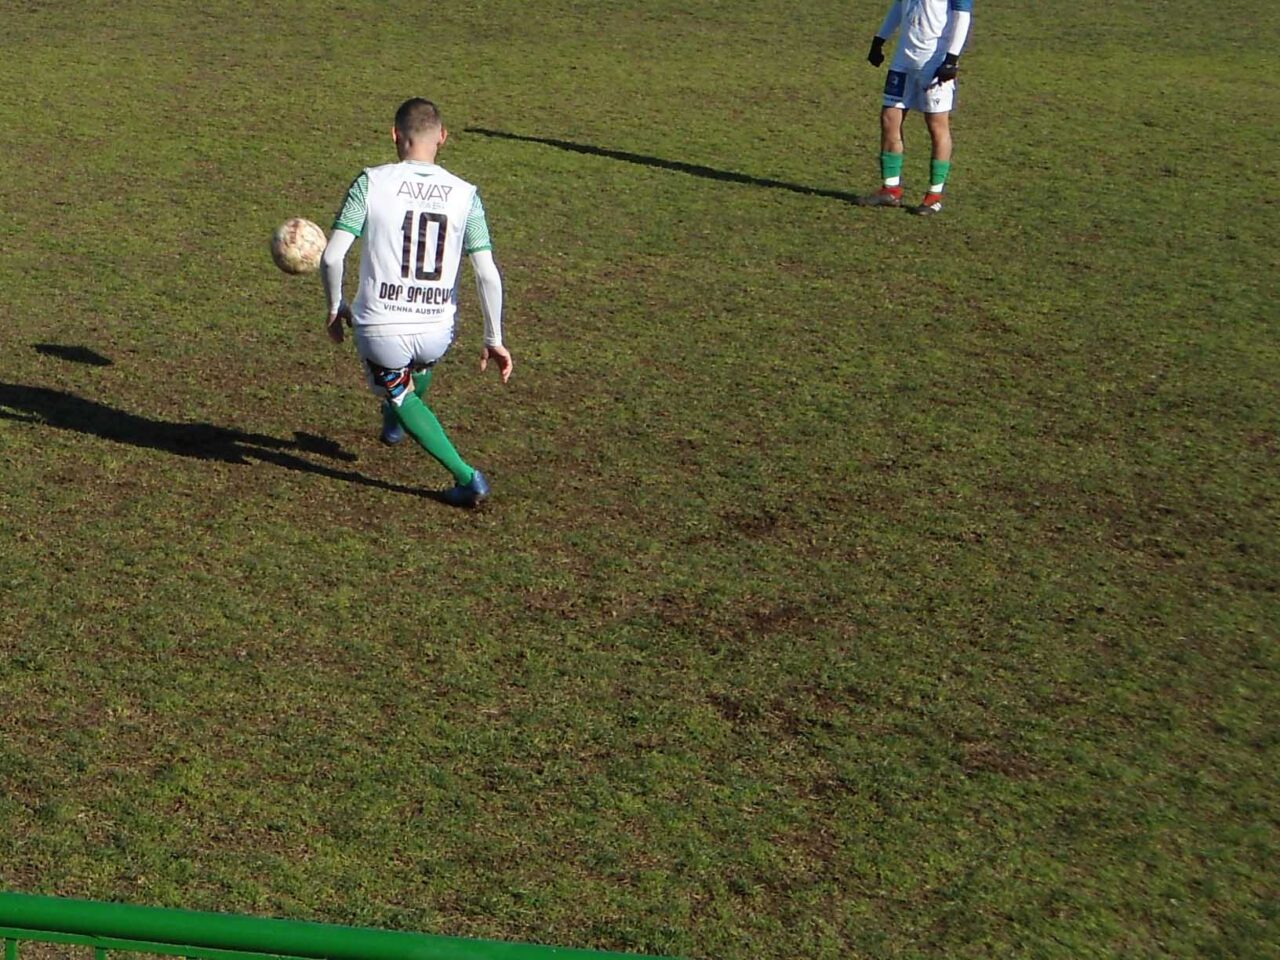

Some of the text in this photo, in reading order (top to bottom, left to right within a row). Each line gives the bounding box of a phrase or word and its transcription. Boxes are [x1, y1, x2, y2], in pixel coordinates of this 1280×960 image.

[396, 180, 453, 203] AWAY
[401, 209, 448, 282] 10
[383, 303, 414, 314] VIENNA
